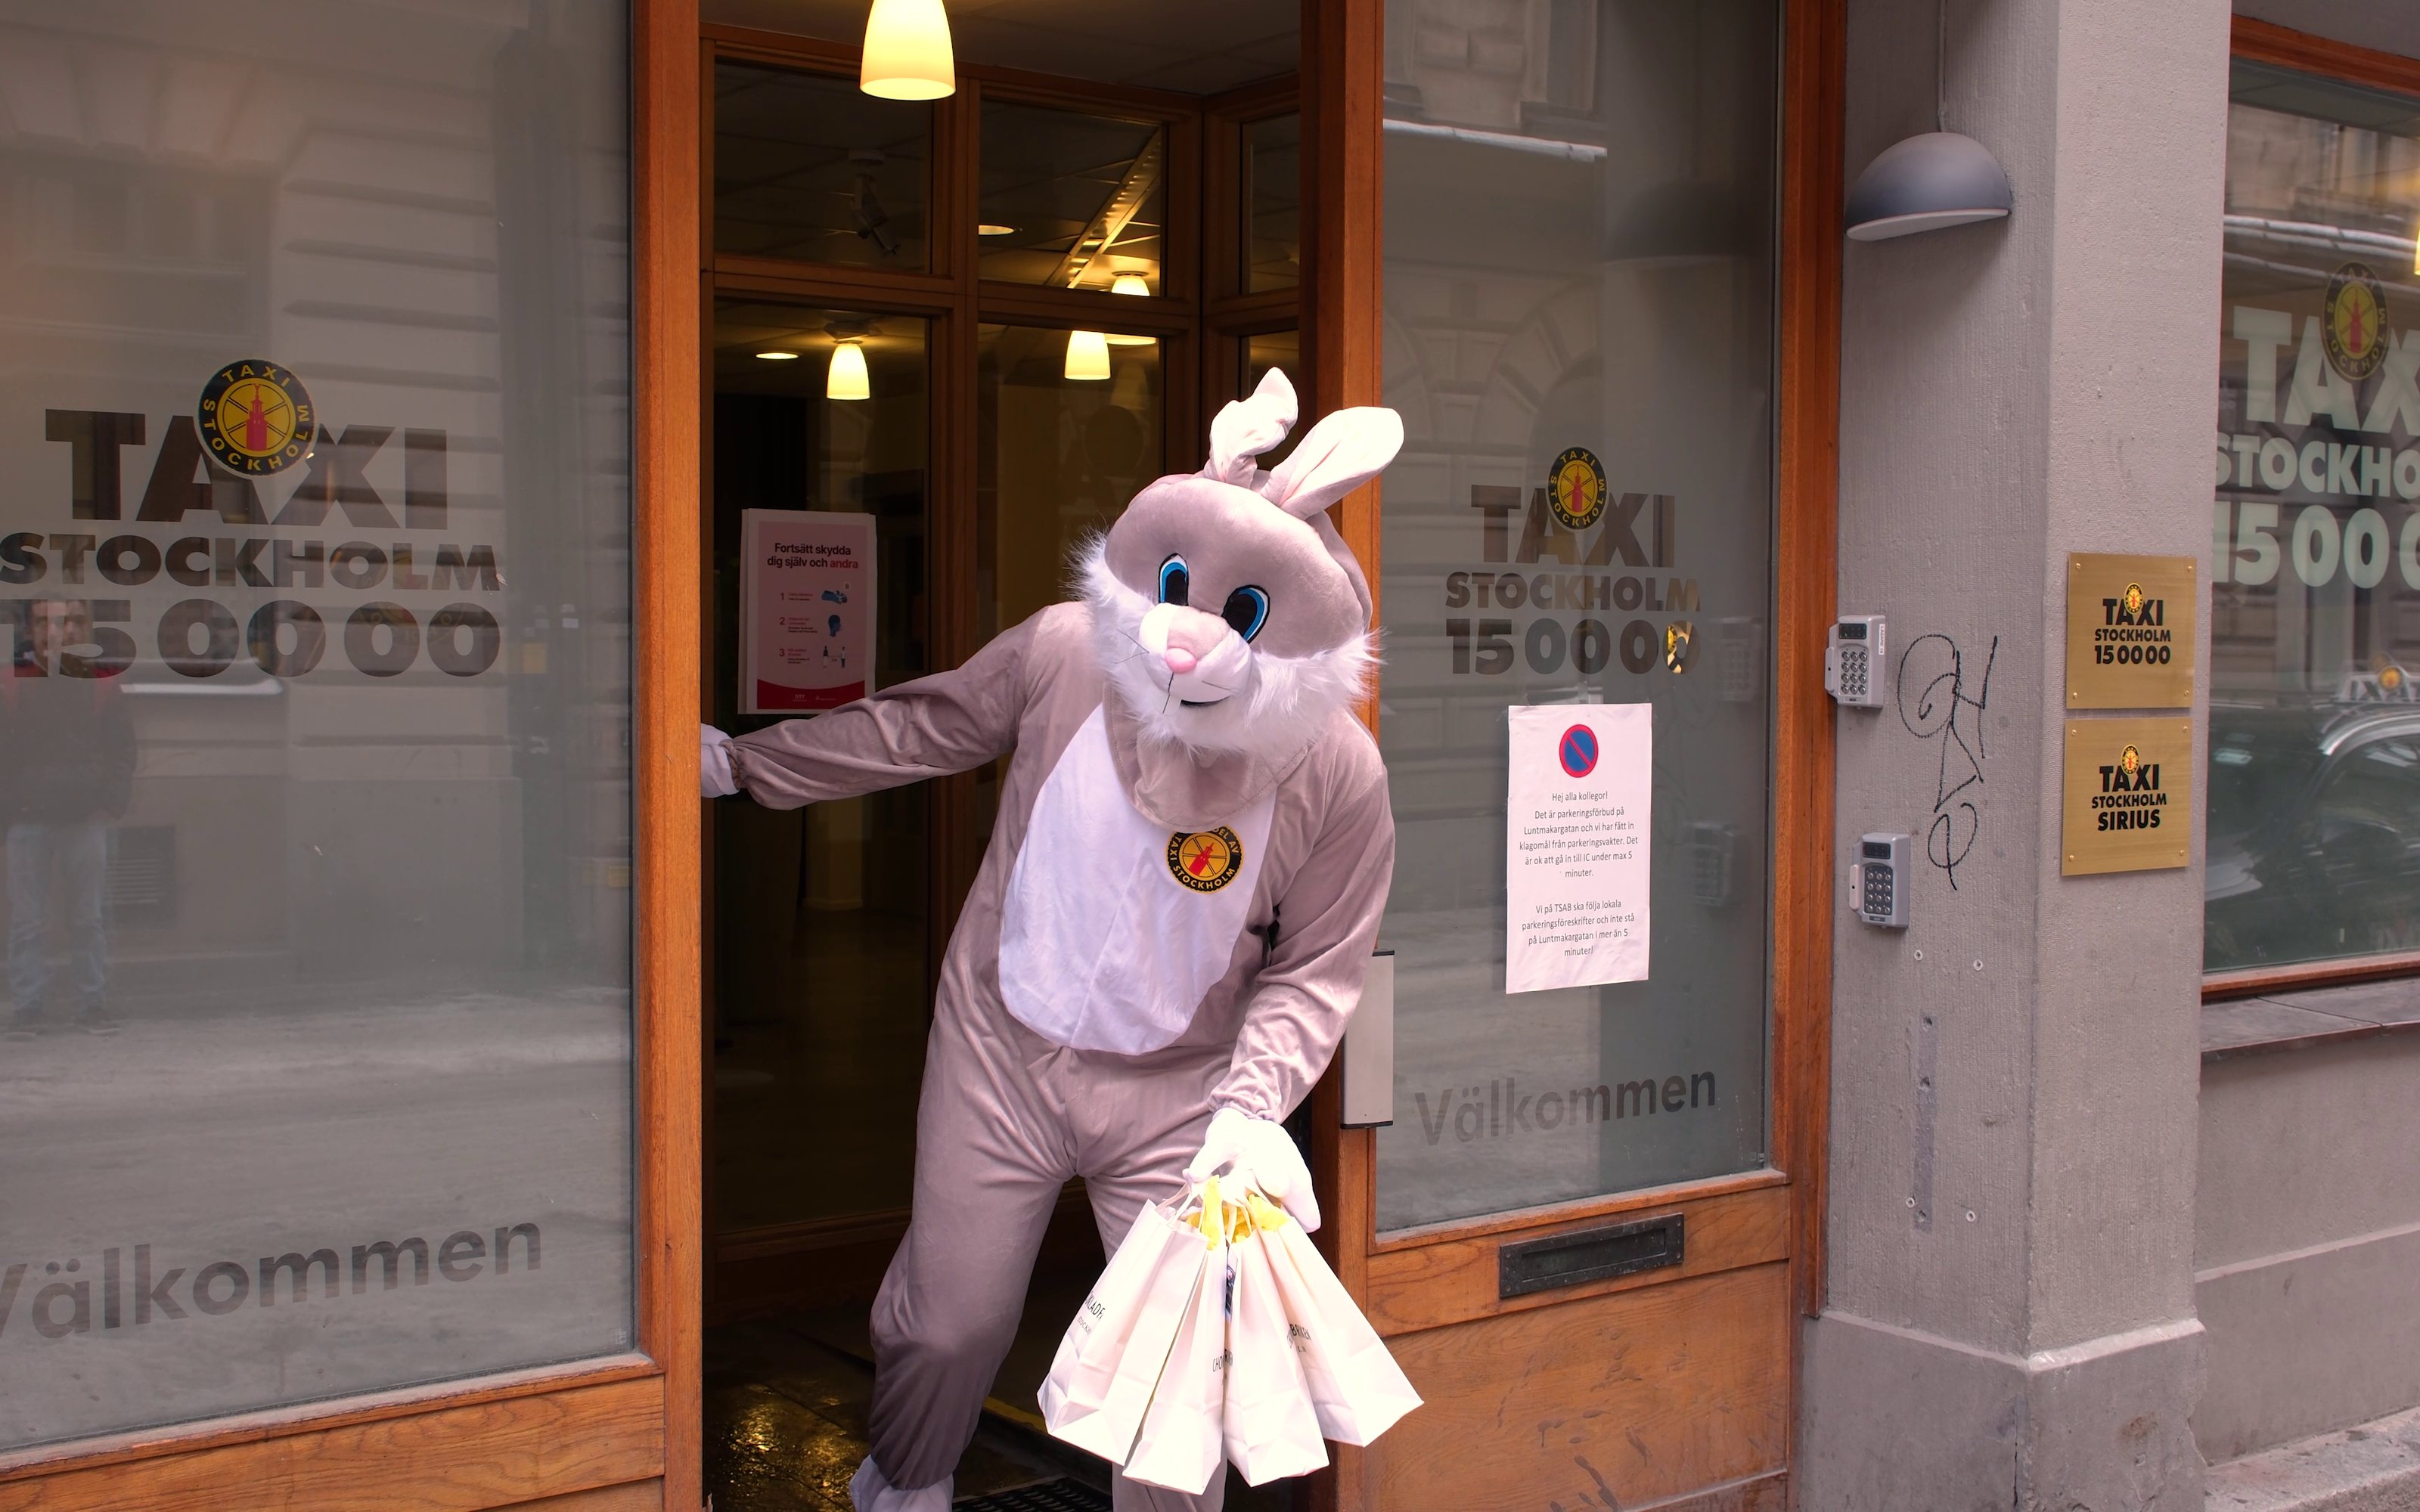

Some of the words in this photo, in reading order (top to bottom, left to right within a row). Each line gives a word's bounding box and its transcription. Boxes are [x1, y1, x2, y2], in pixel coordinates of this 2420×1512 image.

[222, 364, 290, 387] TAXI
[203, 398, 310, 471] STOCKHOLM
[1560, 451, 1596, 466] TAXI
[45, 409, 448, 529] TAXI
[1550, 476, 1605, 526] STOCKHOLM
[1471, 485, 1675, 568] TAXI
[774, 542, 813, 554] Fortsätt
[815, 545, 852, 557] skydda
[0, 532, 500, 591] STOCKHOLM
[767, 556, 783, 569] dig
[785, 556, 807, 569] själv
[809, 558, 828, 568] och
[830, 559, 858, 569] andra
[780, 593, 785, 601] 1
[1445, 572, 1701, 612] STOCKHOLM
[2102, 598, 2164, 626] TAXI
[780, 617, 786, 626] 2
[2095, 628, 2171, 643] STOCKHOLM
[779, 649, 785, 657] 3
[2099, 764, 2159, 792] TAXI
[1552, 793, 1563, 803] Hej
[1565, 792, 1577, 801] alla
[1579, 791, 1608, 802] kollegor!
[2092, 793, 2167, 809] STOCKHOLM
[1535, 810, 1547, 820] Det
[1549, 810, 1556, 819] är
[1558, 808, 1615, 820] parkeringsförbud
[1616, 807, 1624, 817] på
[2098, 809, 2160, 832] SIRIUS
[1524, 825, 1579, 835] Luntmakargatan
[1581, 824, 1593, 832] och
[1602, 823, 1613, 831] har
[1615, 822, 1627, 830] fått
[1628, 821, 1634, 829] in
[1169, 836, 1183, 860] TAXI
[1228, 841, 1239, 854] AV
[1519, 841, 1550, 852] klagomål
[1552, 840, 1565, 848] från
[1568, 838, 1624, 849] parkeringsvakter.
[1627, 836, 1638, 844] Det
[1525, 857, 1533, 866] är
[1544, 856, 1553, 864] att
[1555, 855, 1563, 866] gå
[1574, 854, 1582, 863] till
[1584, 854, 1590, 862] IC
[1592, 853, 1611, 861] under
[1173, 866, 1235, 889] STOCKHOLM
[1565, 869, 1593, 878] minuter.
[1544, 904, 1553, 915] på
[1555, 903, 1571, 912] TSAB
[1573, 902, 1584, 910] ska
[1586, 901, 1600, 911] följa
[1602, 900, 1621, 909] lokala
[1522, 916, 1595, 931] parkeringsföreskrifter
[1596, 916, 1609, 924] och
[1610, 914, 1623, 922] inte
[1624, 913, 1634, 922] stå
[1528, 935, 1537, 946] på
[1539, 932, 1593, 943] Luntmakargatan
[1613, 929, 1622, 937] än
[1624, 928, 1628, 937] 5
[1414, 1070, 1715, 1146] Välkommen
